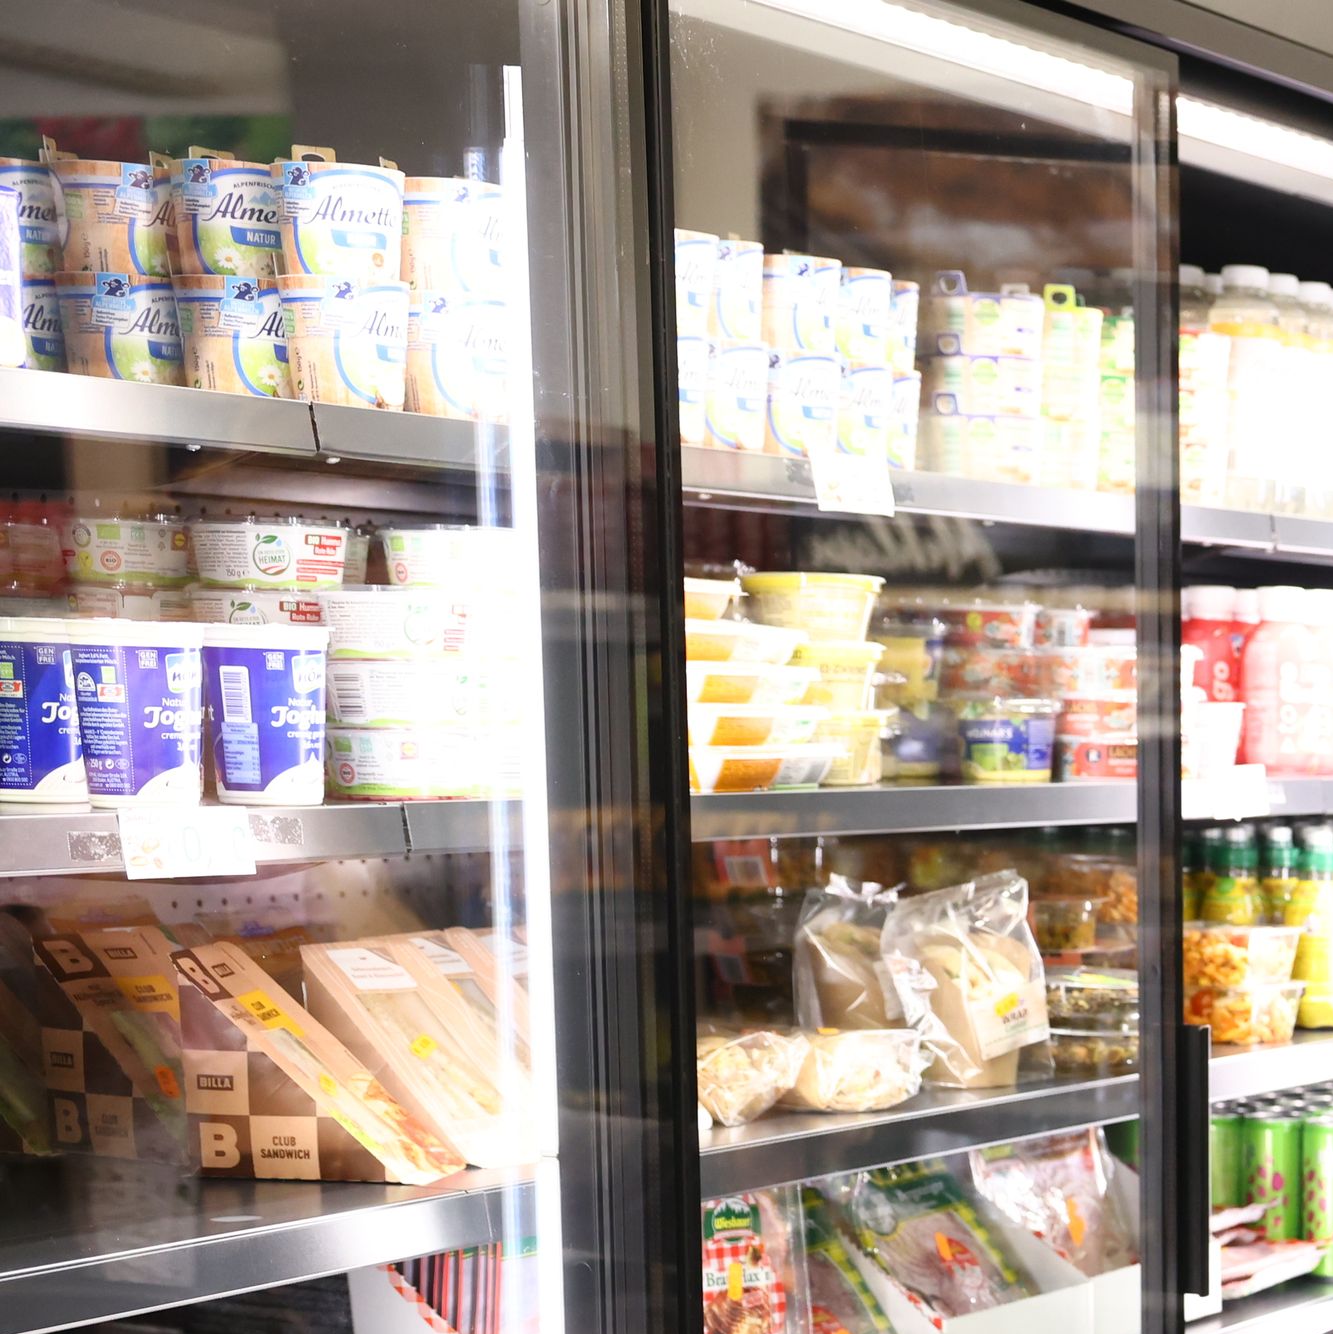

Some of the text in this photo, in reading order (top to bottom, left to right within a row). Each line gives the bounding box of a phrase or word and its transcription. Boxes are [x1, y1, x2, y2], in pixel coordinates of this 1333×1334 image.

[201, 191, 279, 223] Alme
[302, 194, 398, 228] Almette
[246, 229, 277, 245] NATUR
[258, 554, 287, 565] HEIMAT
[38, 647, 54, 655] GEN
[140, 651, 156, 659] GEN
[38, 655, 55, 664] FREI
[42, 940, 94, 975] B
[199, 1076, 232, 1089] BILLA
[53, 1097, 83, 1144] B
[199, 1122, 241, 1169] B
[272, 1136, 296, 1147] CLUB
[260, 1148, 311, 1160] SANDWICH
